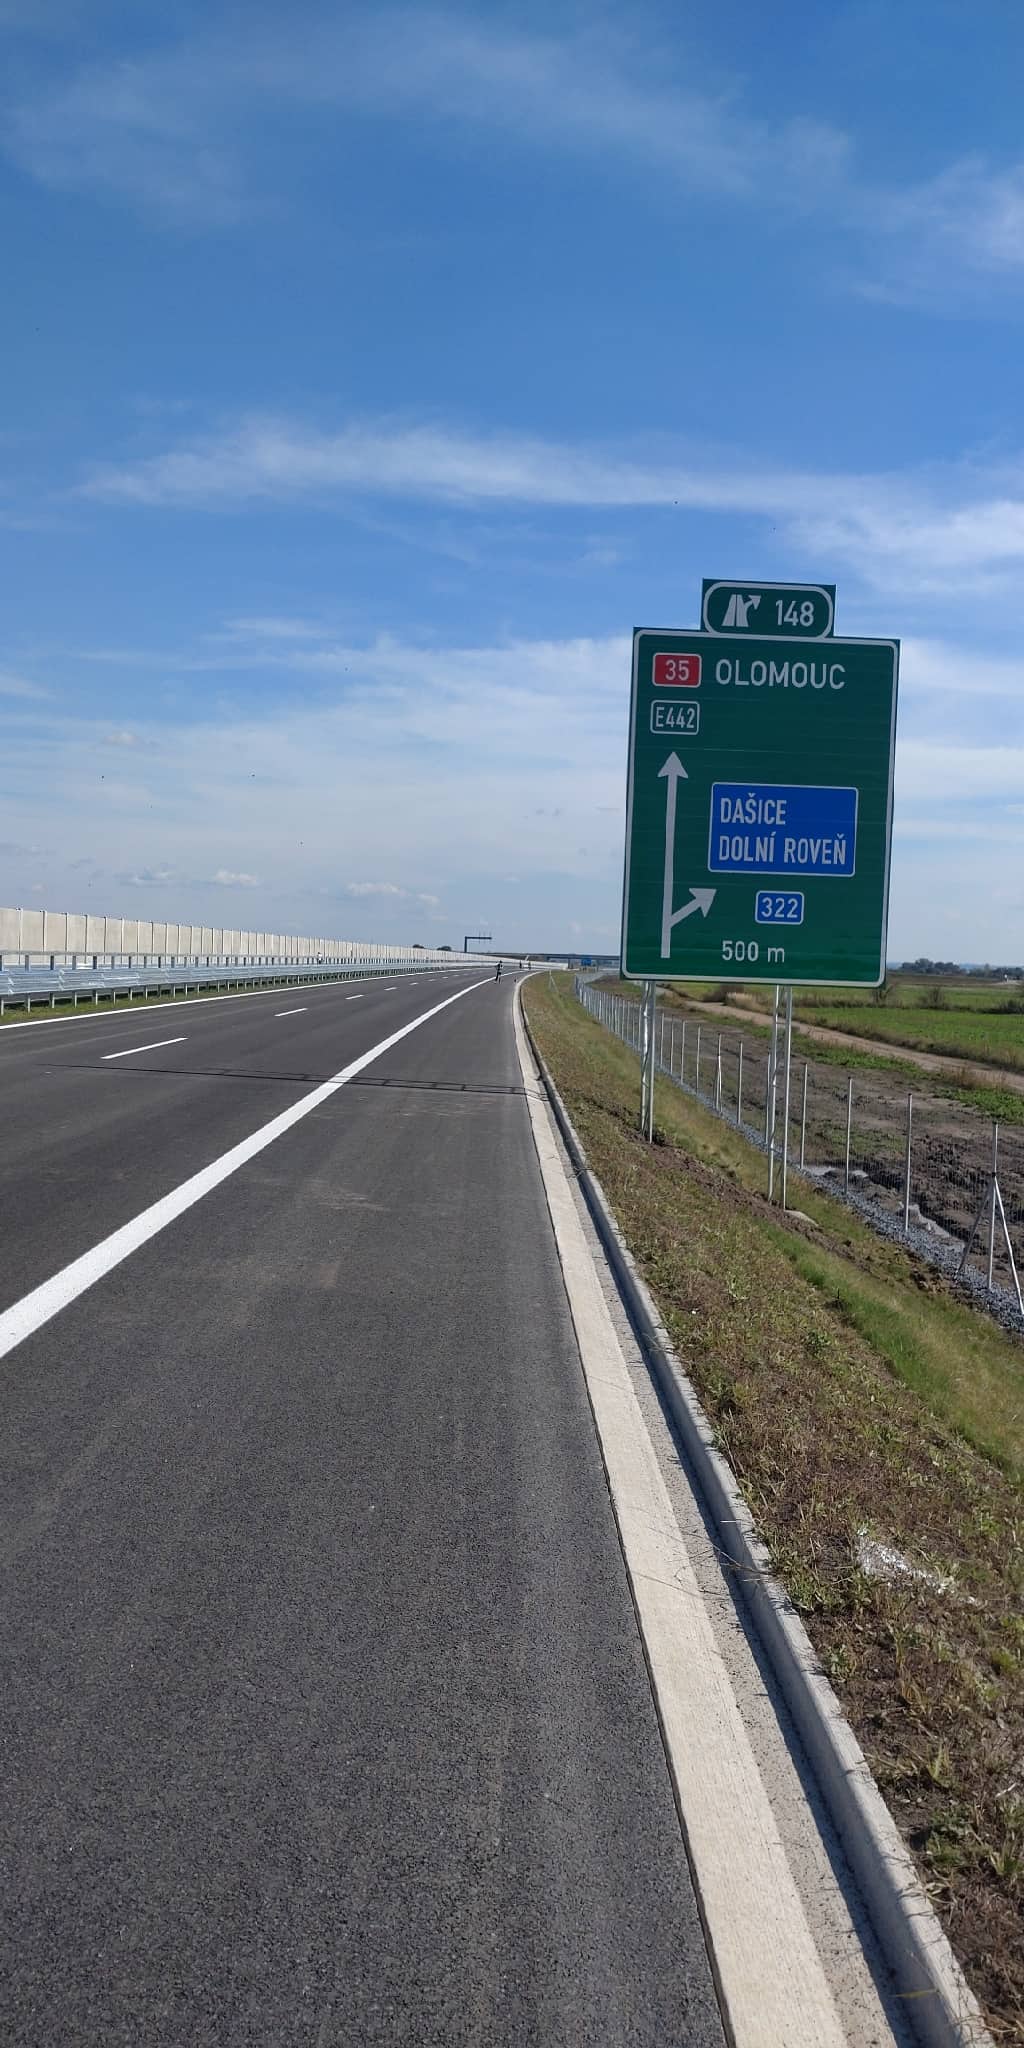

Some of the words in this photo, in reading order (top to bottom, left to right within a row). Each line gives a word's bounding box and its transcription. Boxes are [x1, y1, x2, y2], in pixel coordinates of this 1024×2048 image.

[775, 600, 814, 627] 148
[665, 660, 690, 681] 35
[715, 659, 845, 689] OLOMOUC
[655, 706, 695, 729] E442
[720, 792, 787, 825] DAŠICE
[719, 831, 777, 863] DOLNÍ
[784, 833, 846, 865] ROVEŇ
[761, 897, 799, 918] 322
[722, 940, 759, 962] 500
[767, 947, 785, 963] m
